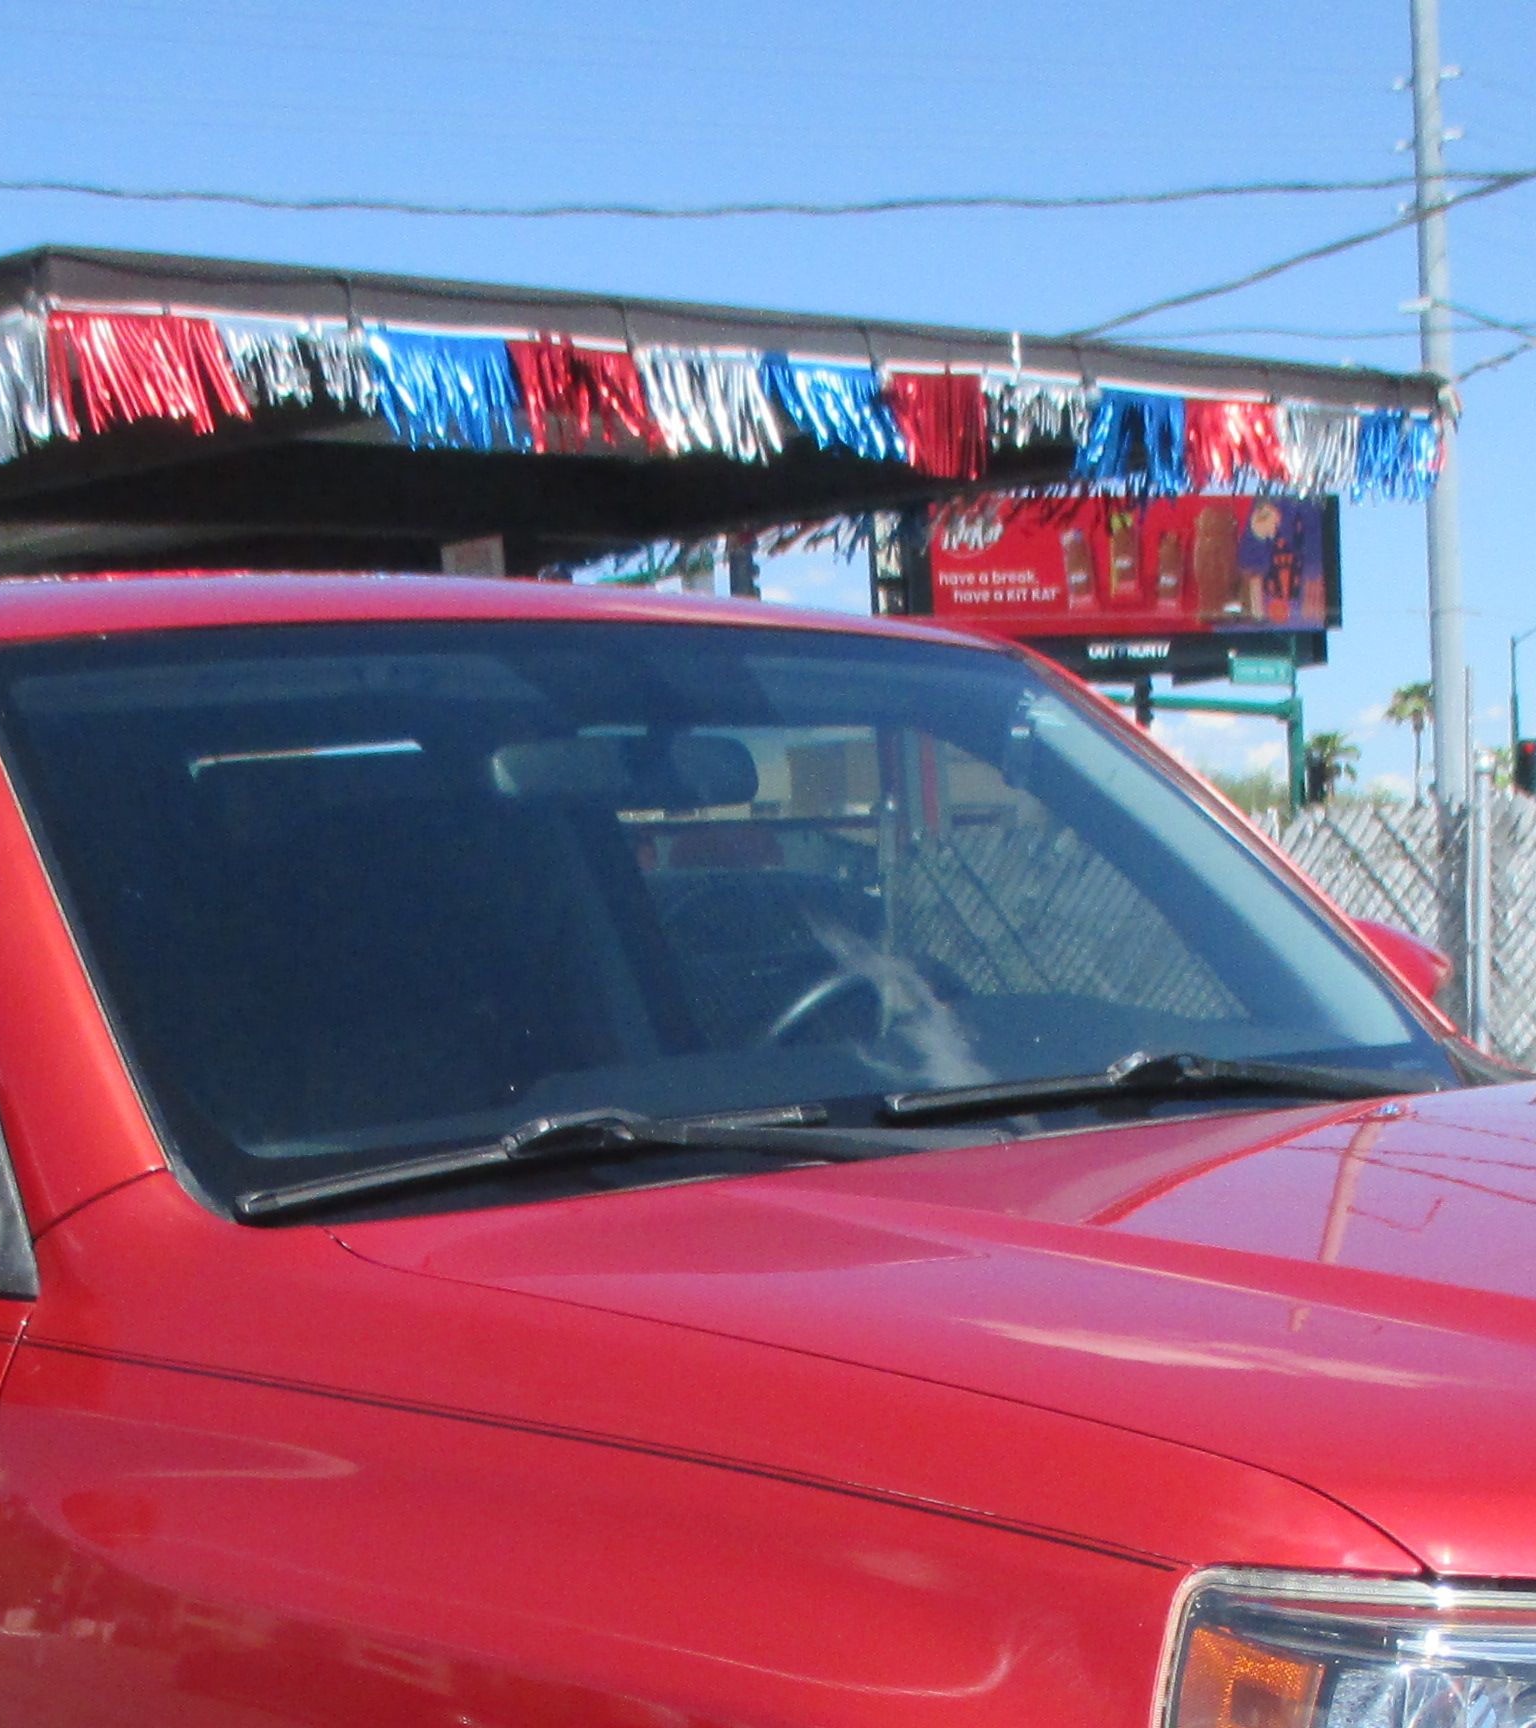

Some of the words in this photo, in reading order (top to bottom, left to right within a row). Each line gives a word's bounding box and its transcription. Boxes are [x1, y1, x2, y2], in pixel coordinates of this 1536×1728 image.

[939, 569, 975, 586] have
[979, 573, 989, 585] a
[954, 589, 990, 603] have
[994, 590, 1004, 601] a
